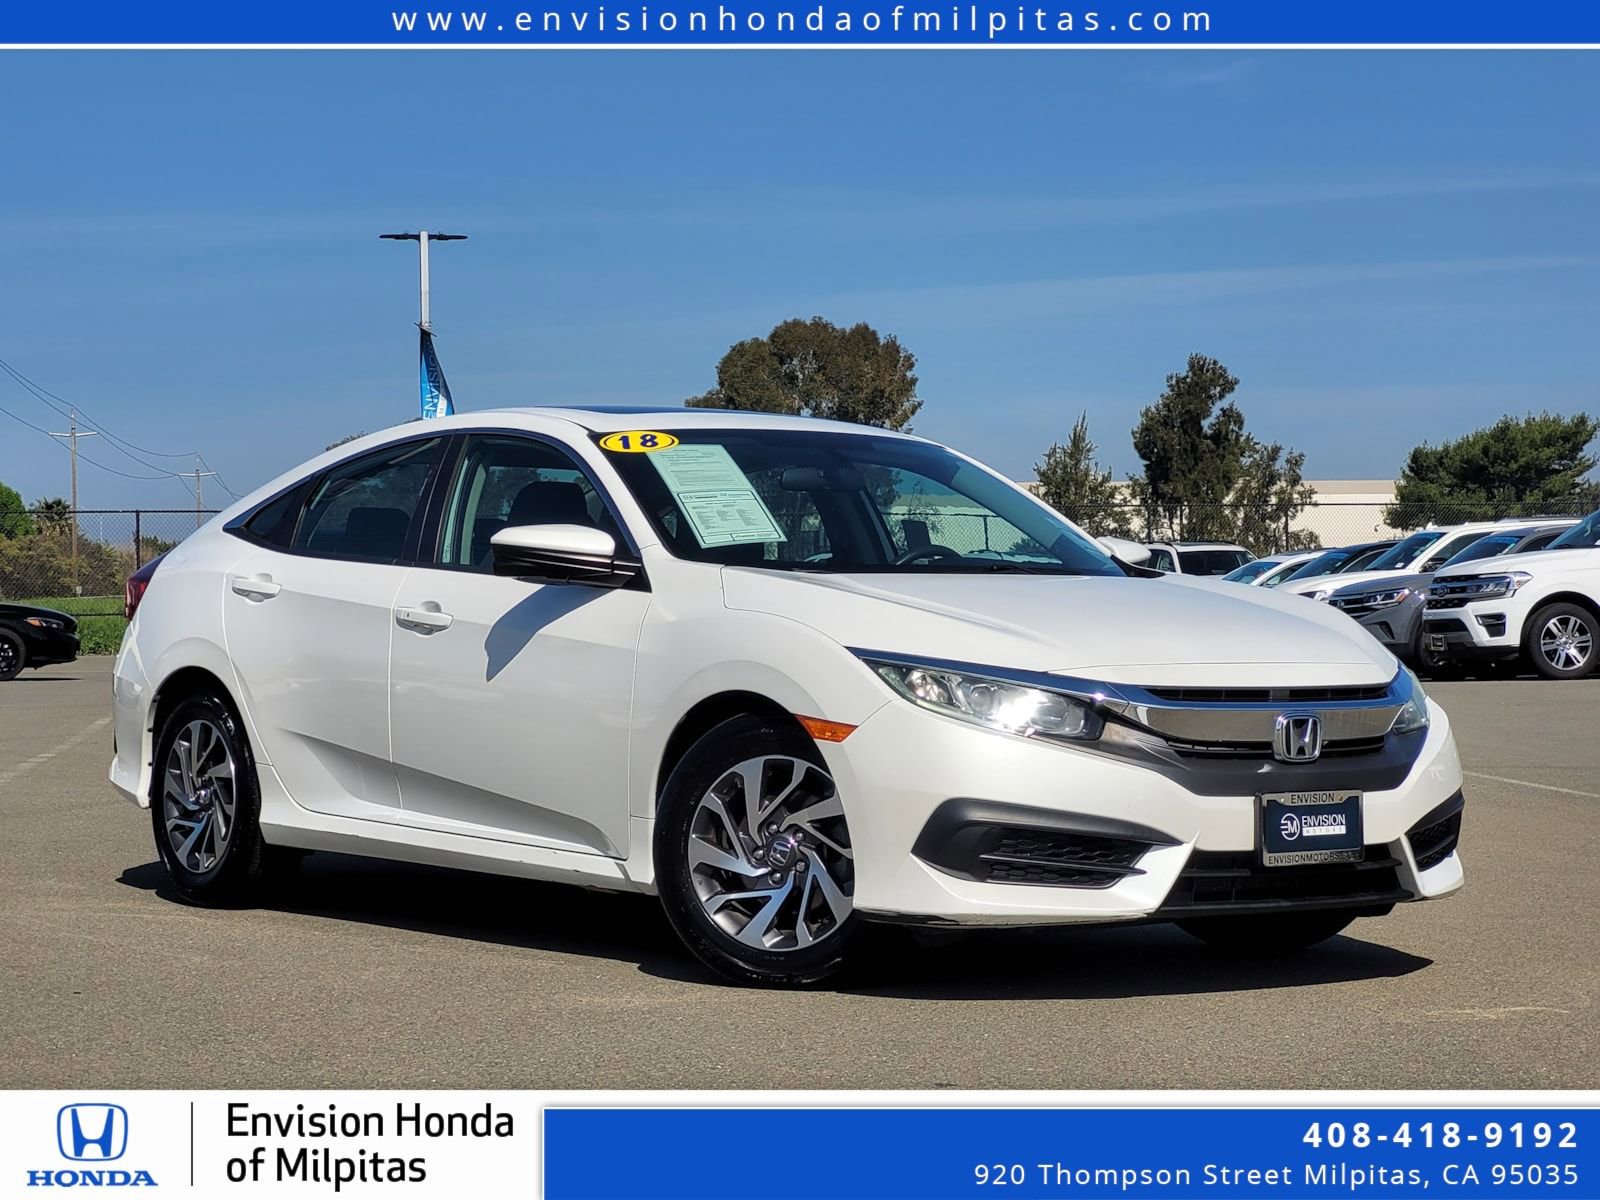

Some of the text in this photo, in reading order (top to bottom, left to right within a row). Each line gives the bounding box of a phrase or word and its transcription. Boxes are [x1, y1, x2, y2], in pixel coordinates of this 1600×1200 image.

[618, 434, 658, 449] 18
[1290, 793, 1335, 804] ENVISION
[1301, 814, 1346, 827] ENVISION
